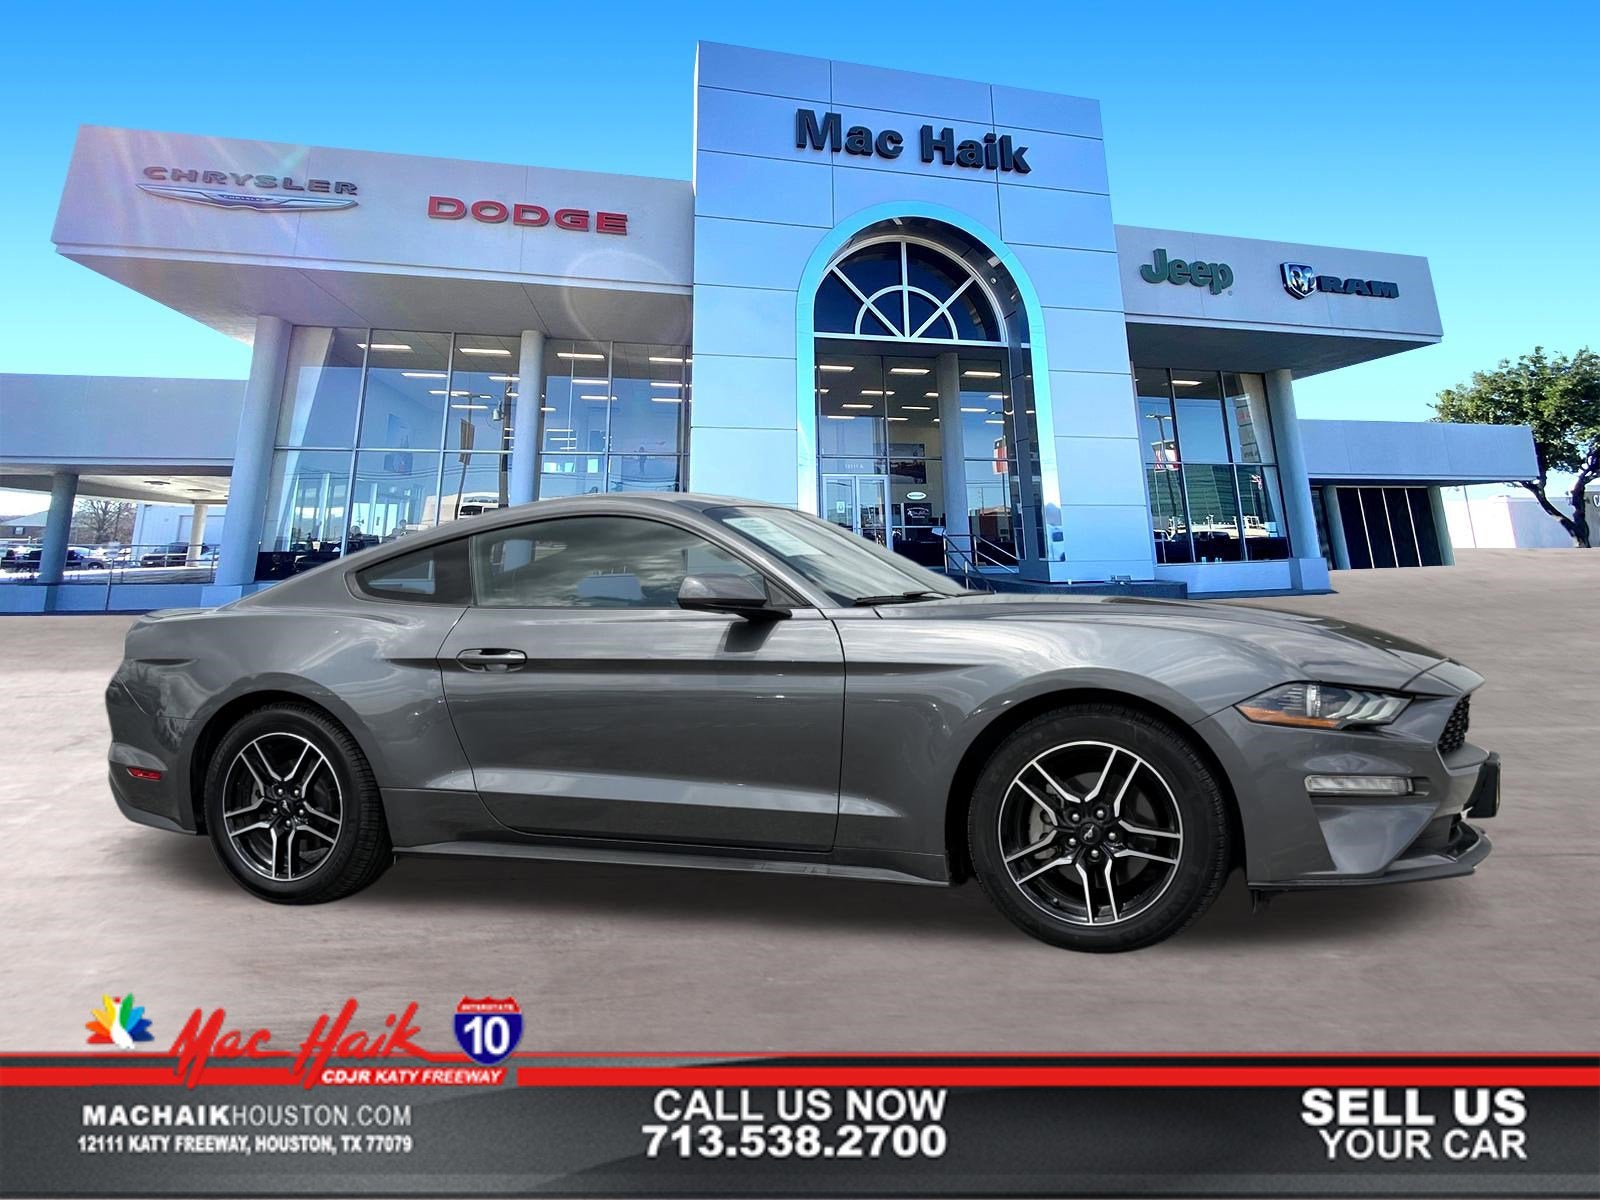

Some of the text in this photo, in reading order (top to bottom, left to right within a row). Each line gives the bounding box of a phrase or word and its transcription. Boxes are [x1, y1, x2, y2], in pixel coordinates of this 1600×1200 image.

[795, 108, 1032, 174] Mac Haik
[143, 165, 359, 196] CHRYSLER
[428, 195, 628, 236] DODGE
[1140, 248, 1234, 295] Jeep
[1316, 275, 1399, 299] RAM
